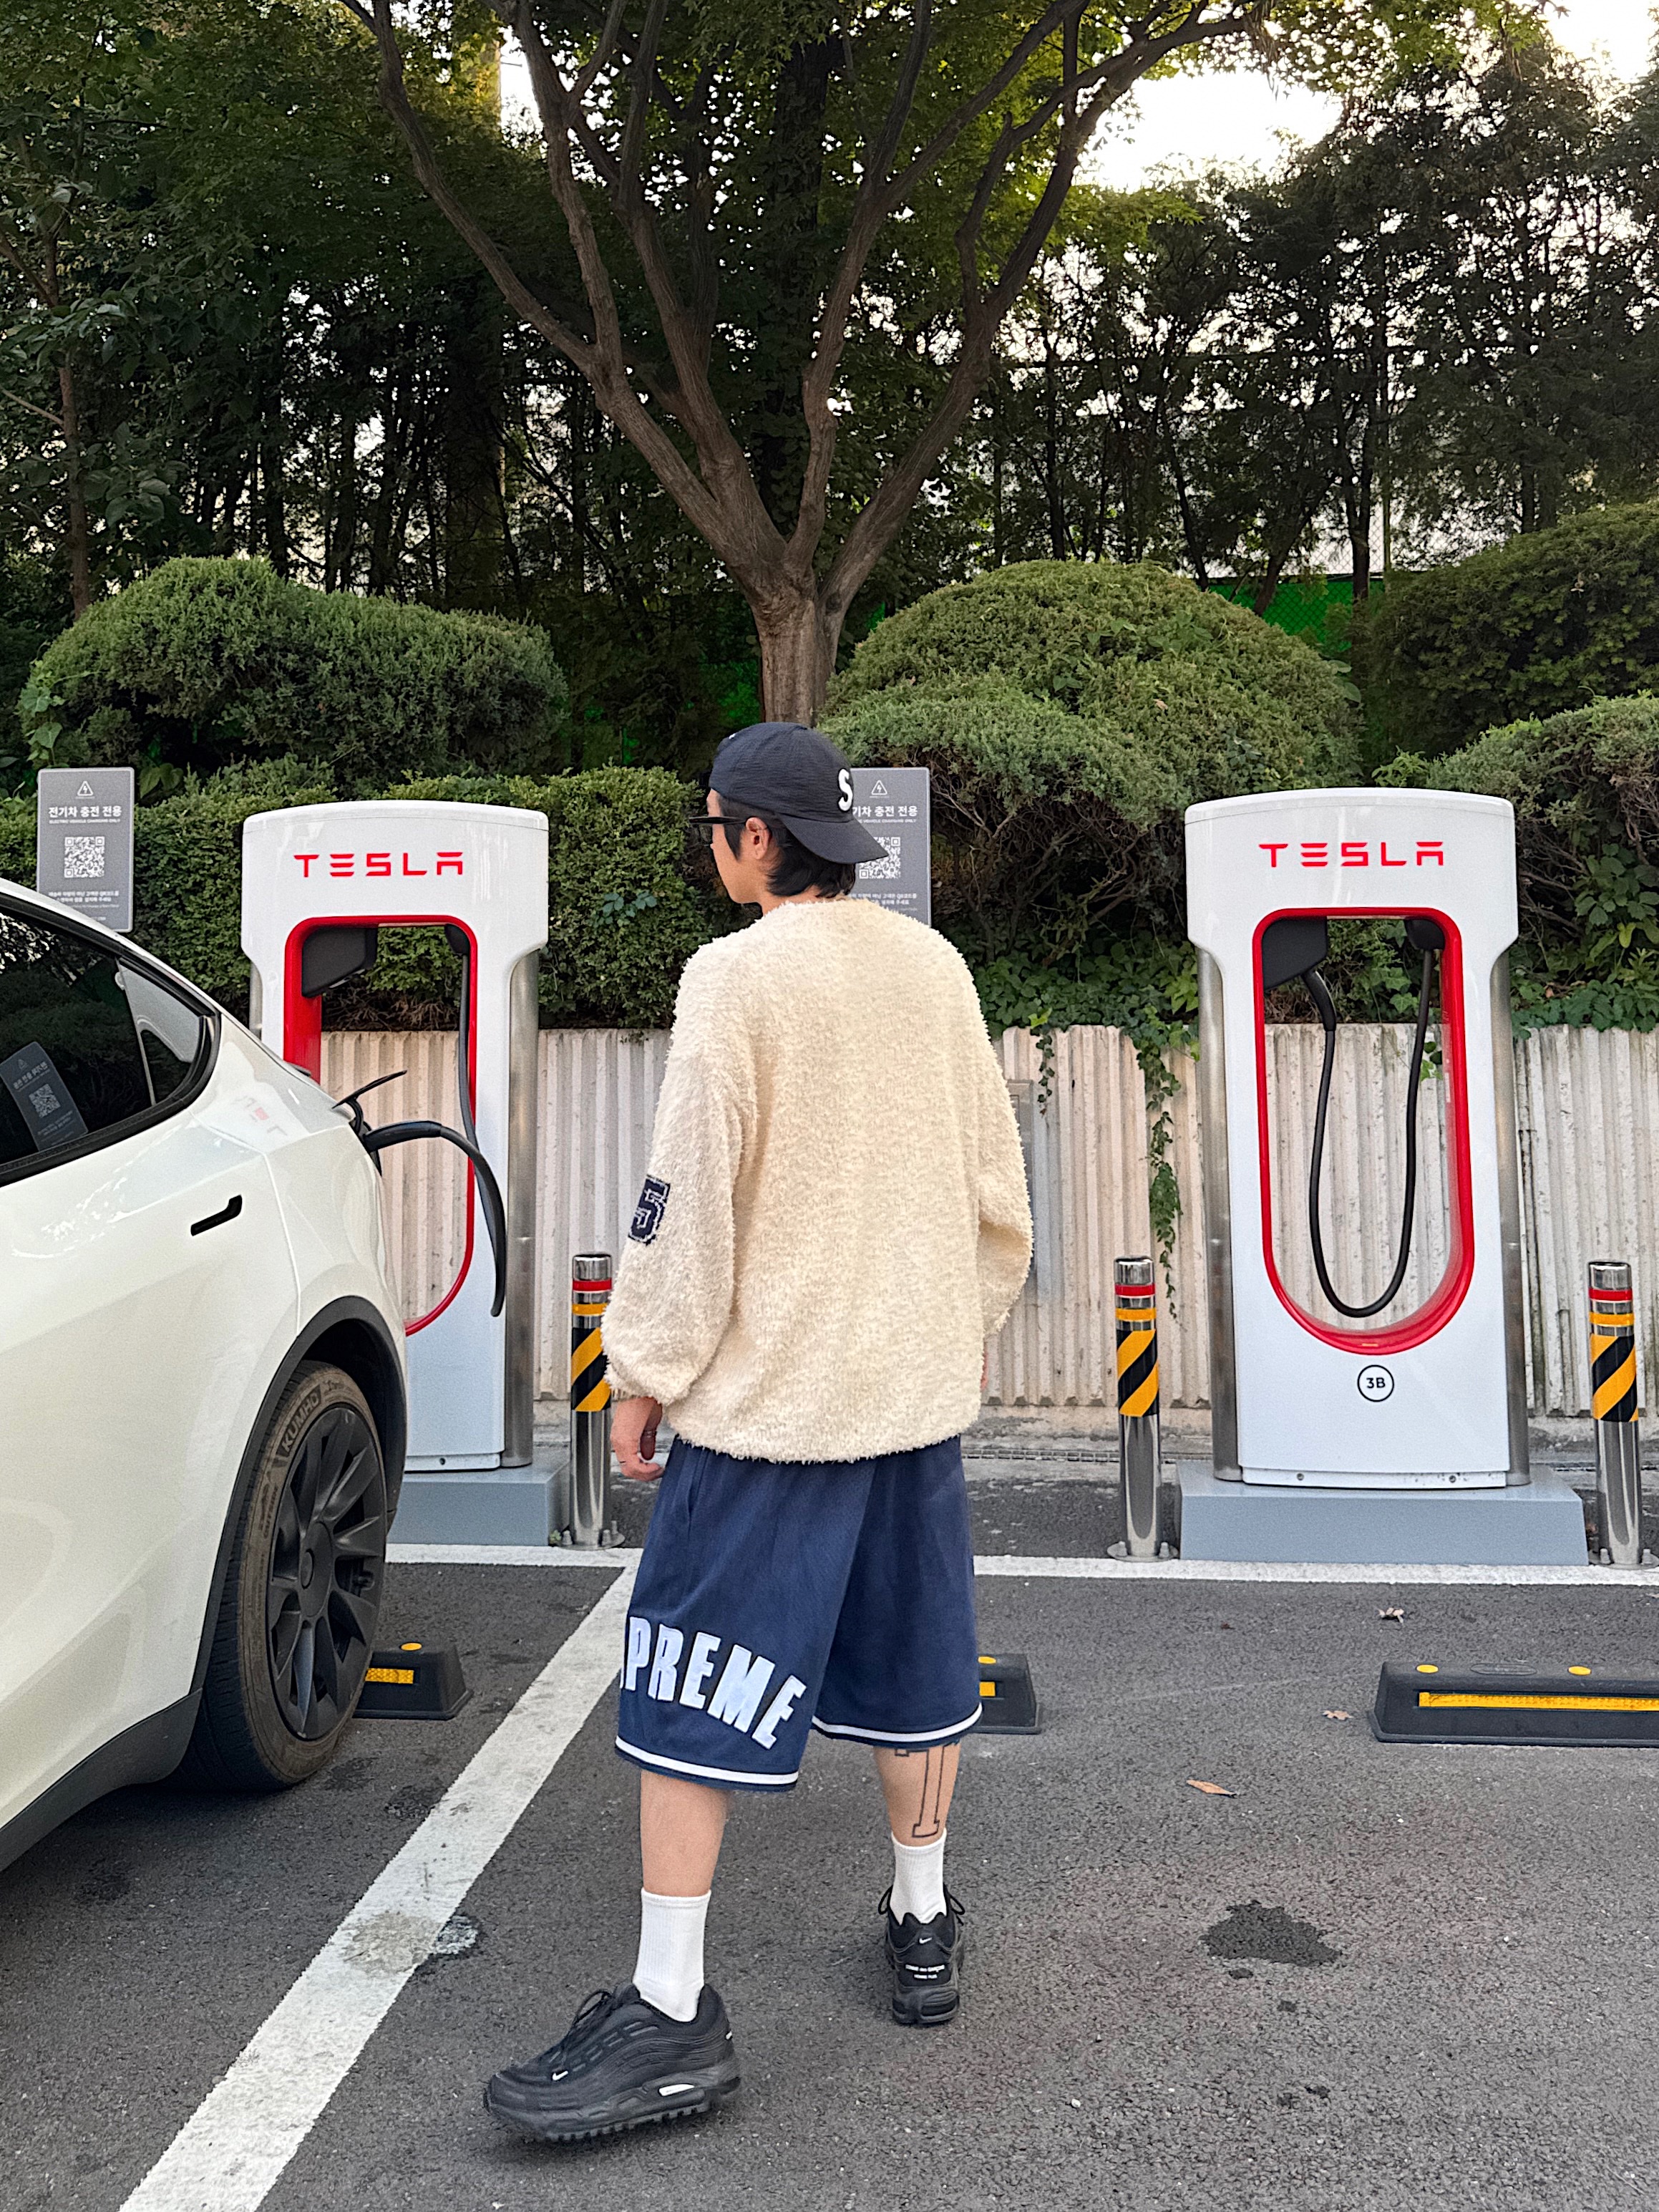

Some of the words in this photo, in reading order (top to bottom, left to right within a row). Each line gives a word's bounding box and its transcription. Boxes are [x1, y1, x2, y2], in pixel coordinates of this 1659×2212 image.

[838, 768, 853, 811] S
[48, 806, 78, 818] 전기차
[80, 805, 99, 818] 충전
[102, 805, 122, 817] 전용
[852, 805, 872, 818] 기차
[874, 805, 895, 817] 충전
[897, 805, 918, 817] 전용
[293, 852, 463, 878] TESLA
[1258, 841, 1444, 868] TESLA
[1366, 1377, 1386, 1389] 3B
[281, 1391, 319, 1452] KUMHO
[620, 1616, 807, 1750] PREME
